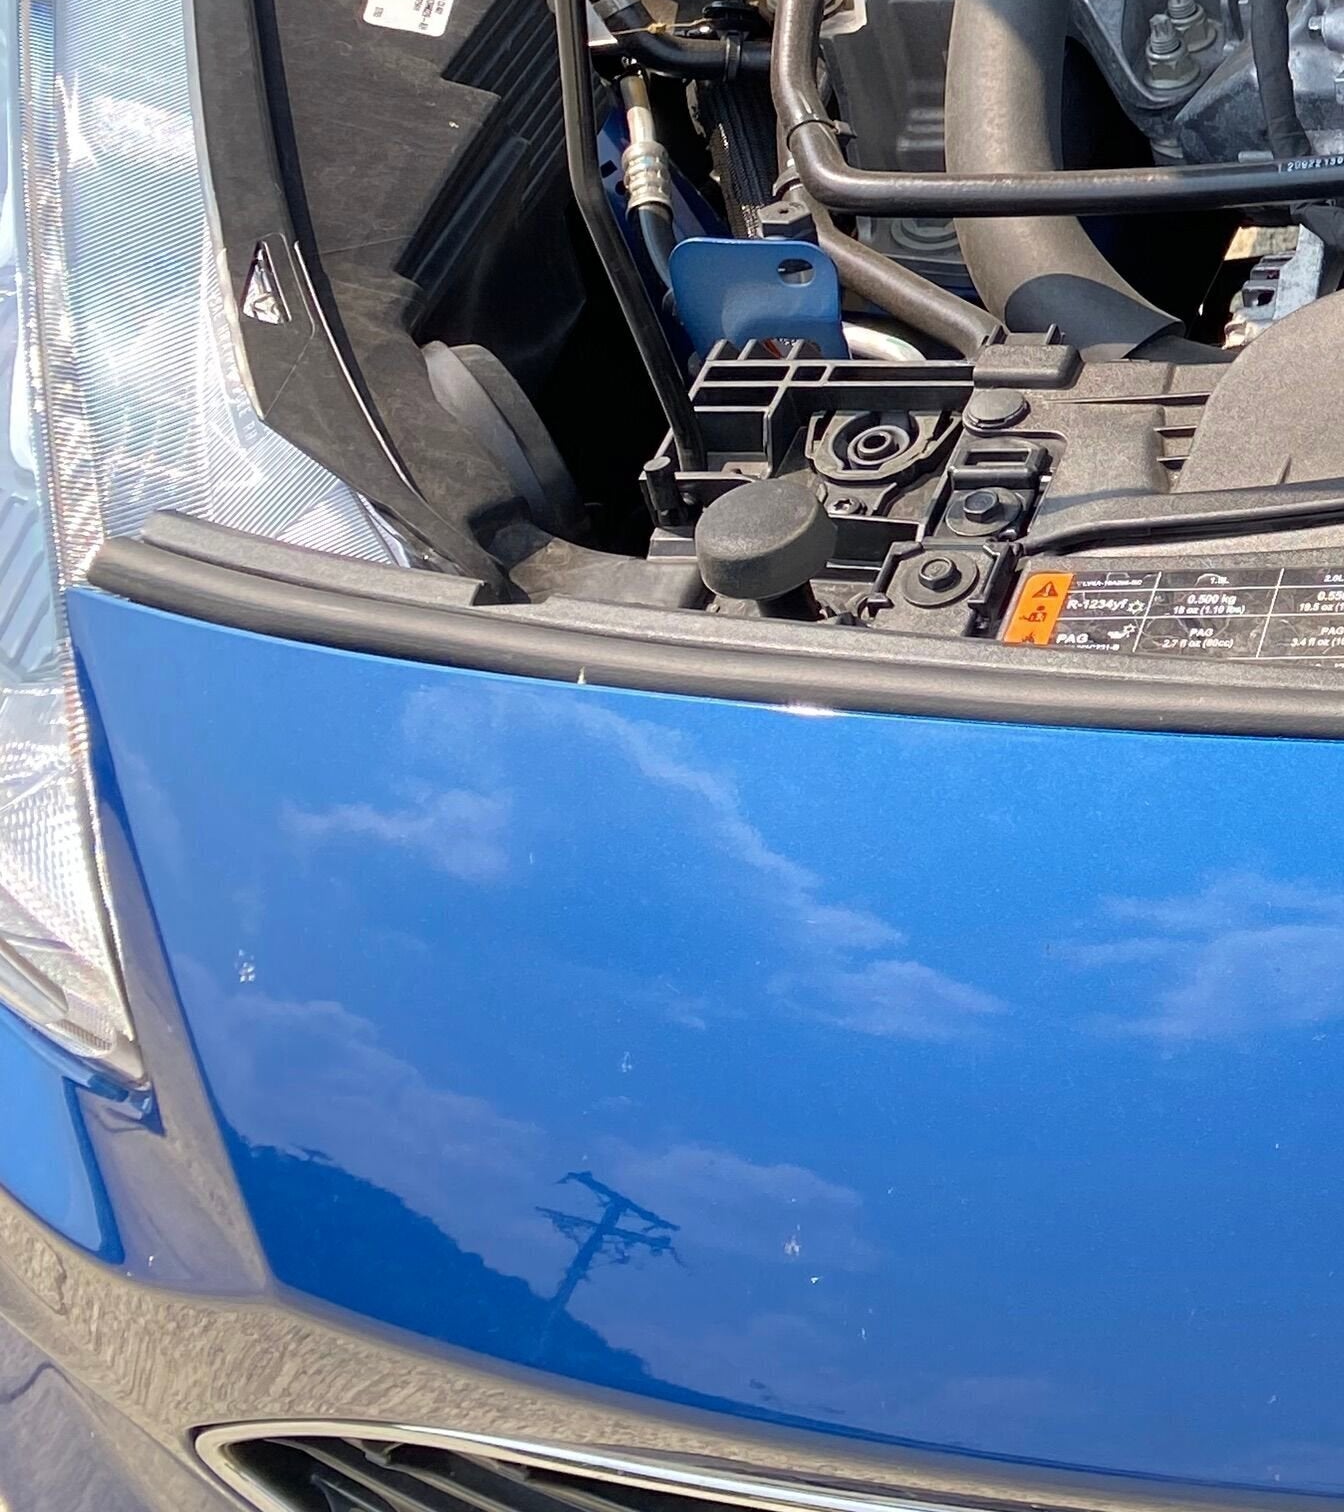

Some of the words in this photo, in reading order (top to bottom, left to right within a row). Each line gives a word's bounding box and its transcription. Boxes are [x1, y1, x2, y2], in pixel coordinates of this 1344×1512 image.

[1066, 598, 1129, 611] R-1234yf
[1187, 594, 1220, 605] 0.500
[1221, 594, 1237, 606] kg
[1190, 628, 1214, 637] PAG
[1320, 626, 1344, 636] PAG
[1056, 633, 1089, 644] PAG
[1188, 640, 1201, 648] oz
